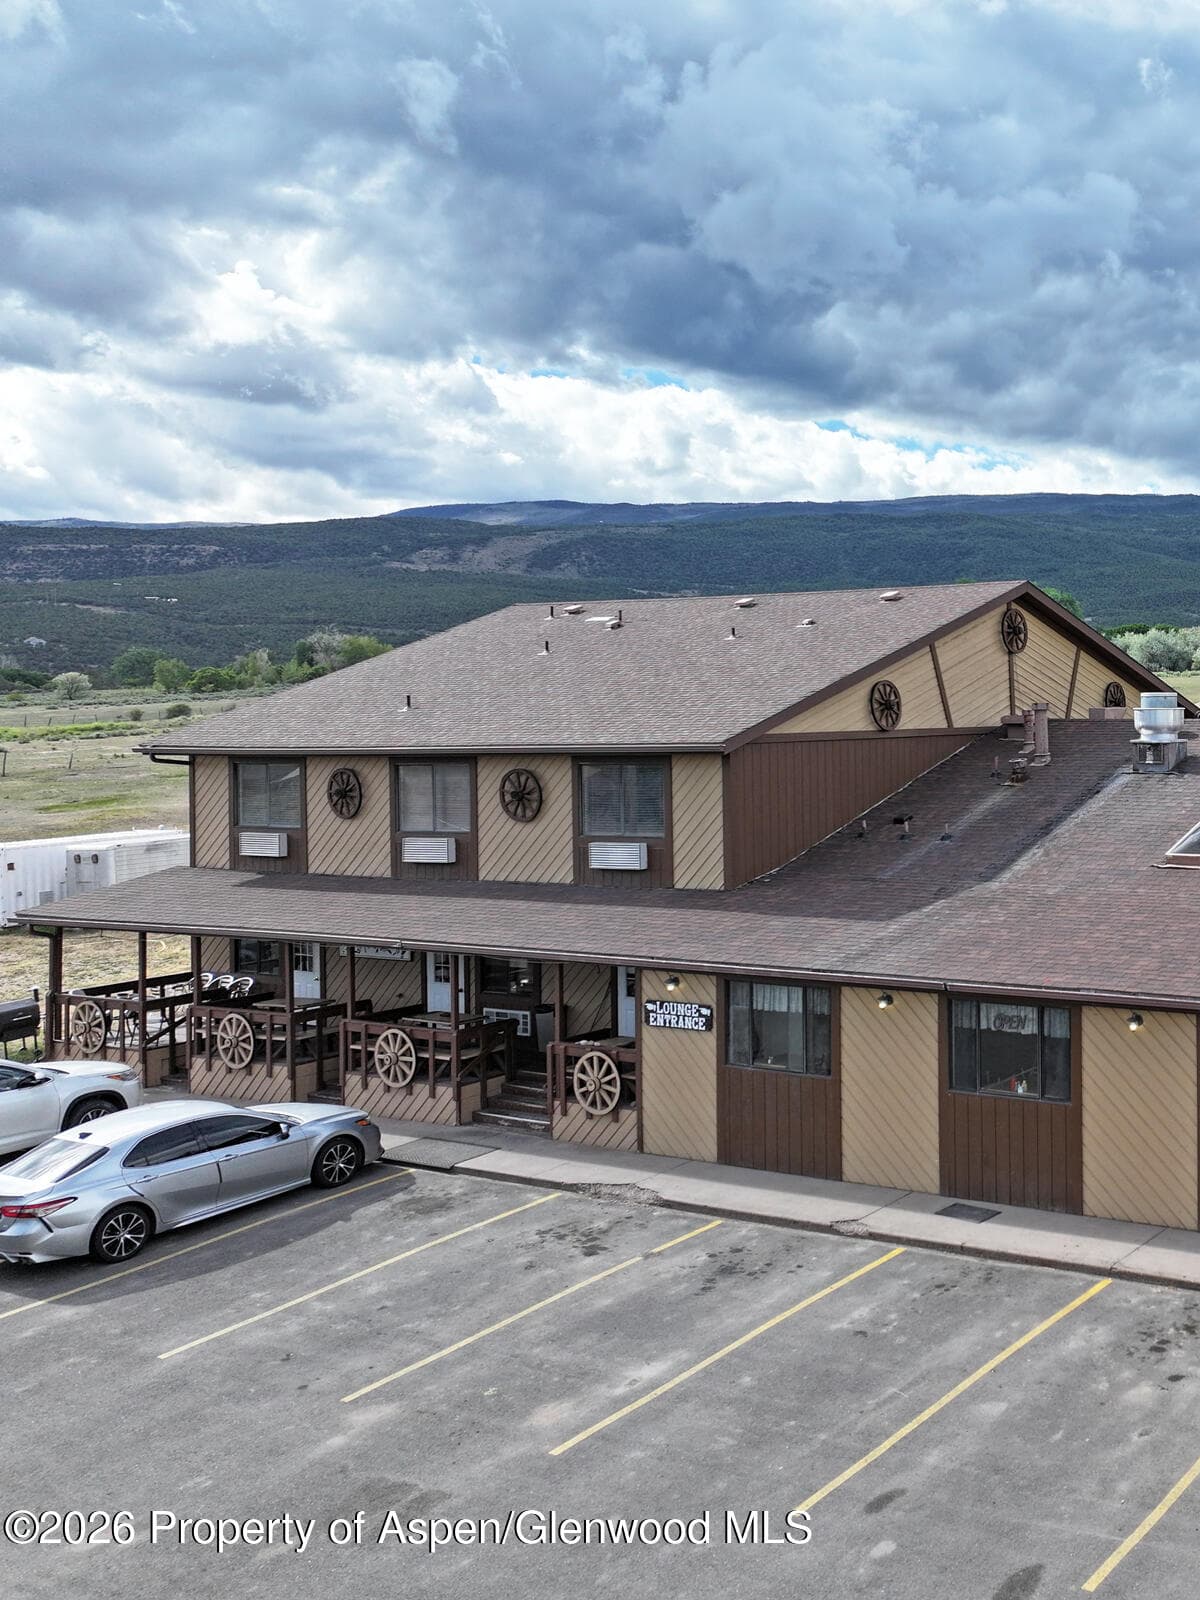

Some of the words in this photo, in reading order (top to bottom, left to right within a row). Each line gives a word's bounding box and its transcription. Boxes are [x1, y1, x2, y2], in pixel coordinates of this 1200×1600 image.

[656, 1001, 699, 1016] LOUNGE
[649, 1013, 706, 1030] ENTRANCE
[993, 1013, 1027, 1030] OPEN
